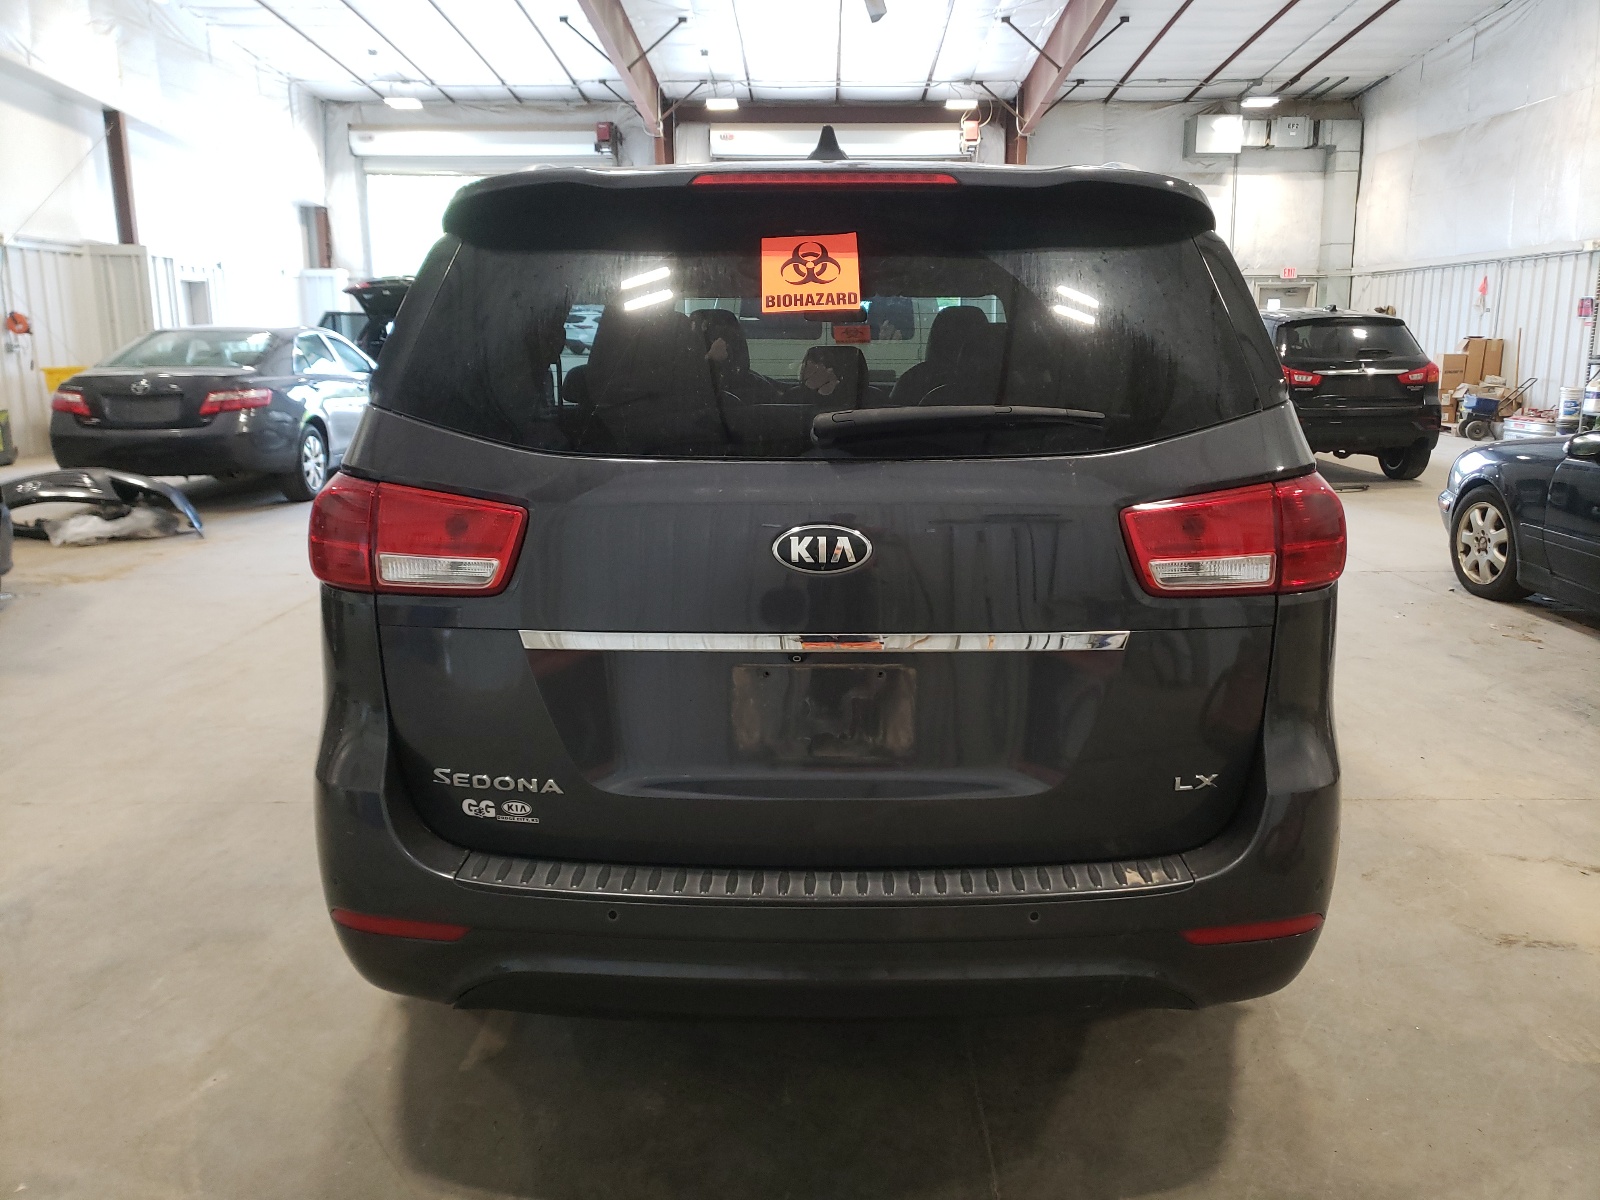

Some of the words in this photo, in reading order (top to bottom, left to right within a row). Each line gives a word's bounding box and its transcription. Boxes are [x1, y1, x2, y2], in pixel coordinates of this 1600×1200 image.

[1283, 268, 1296, 278] EXIT
[765, 292, 858, 308] BIOHAZARD
[789, 536, 857, 564] KIA
[432, 767, 565, 795] SEDONA
[1174, 773, 1219, 791] LX
[507, 804, 527, 813] KIA
